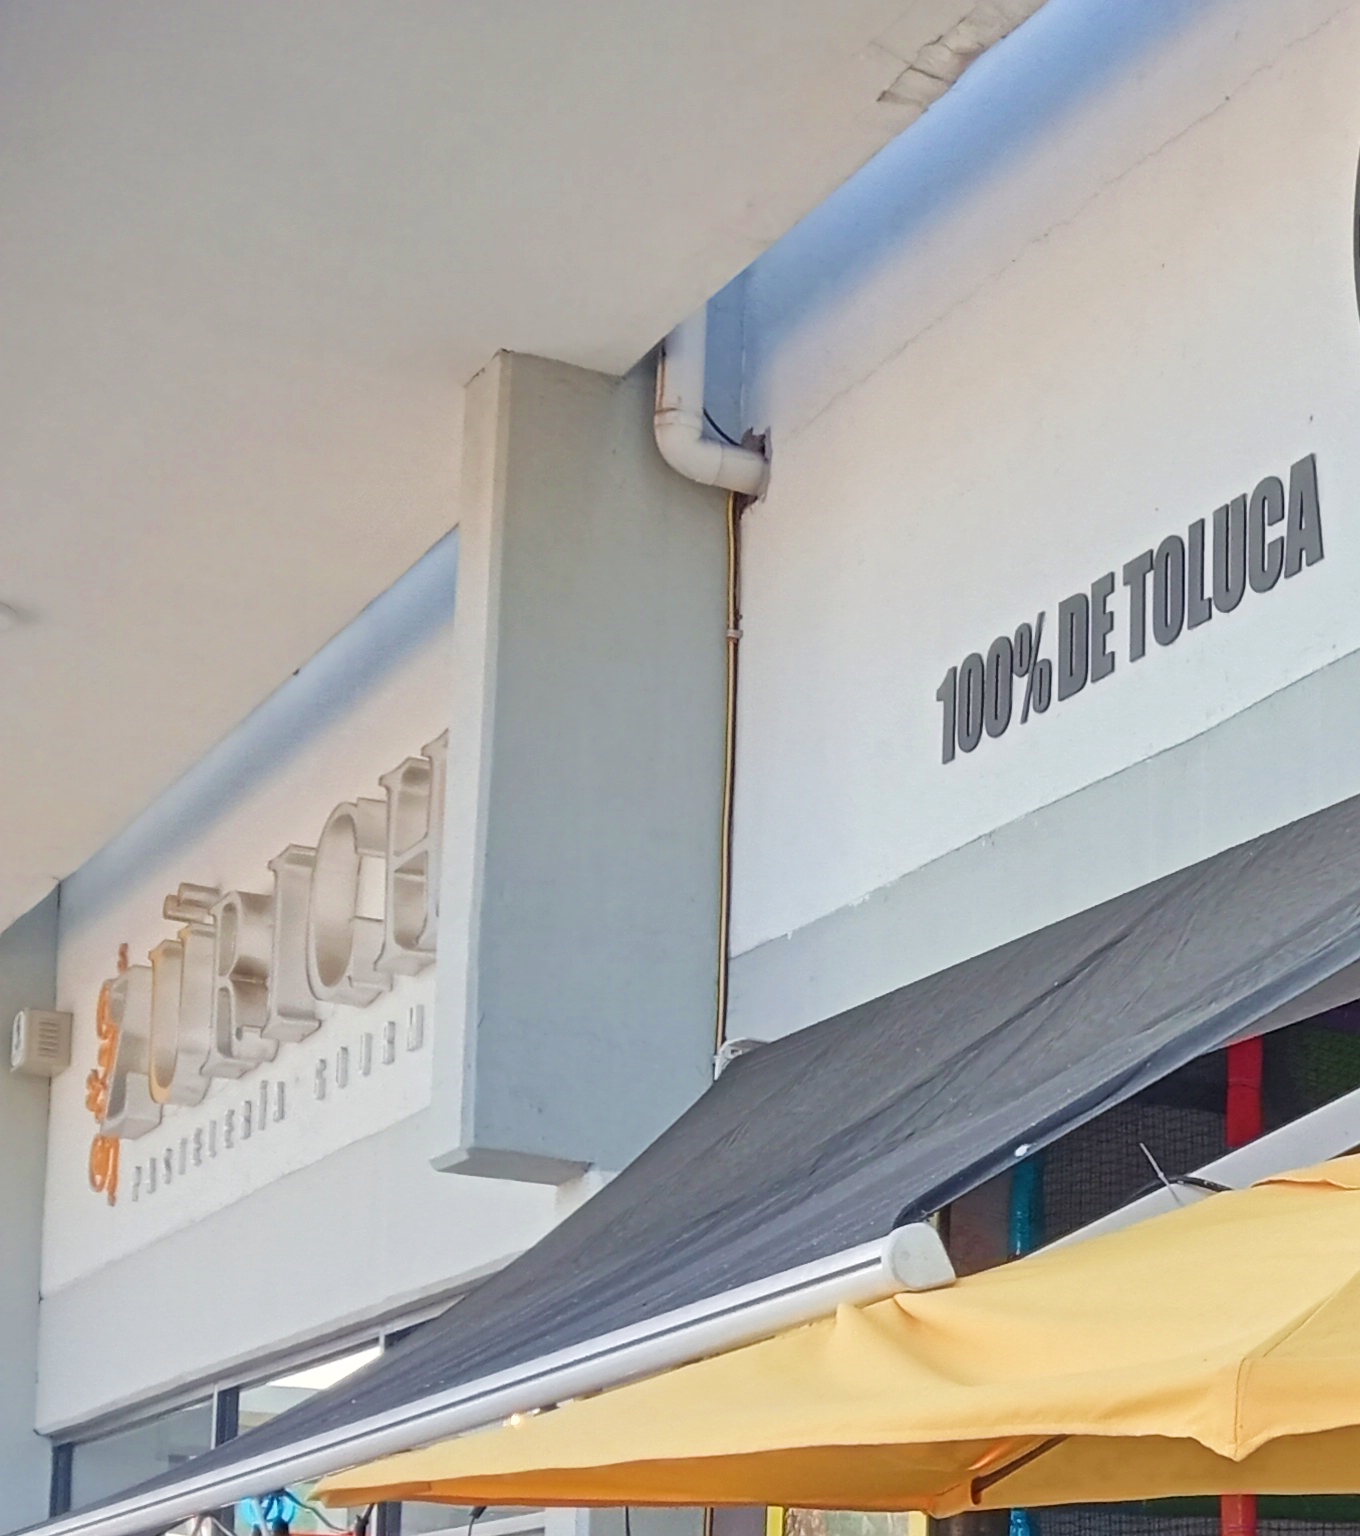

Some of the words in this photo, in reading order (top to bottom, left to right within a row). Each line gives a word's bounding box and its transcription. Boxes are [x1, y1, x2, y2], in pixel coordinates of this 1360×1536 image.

[935, 610, 1053, 765] 100%
[1057, 571, 1116, 702] DE
[1122, 452, 1325, 663] TOLUCA
